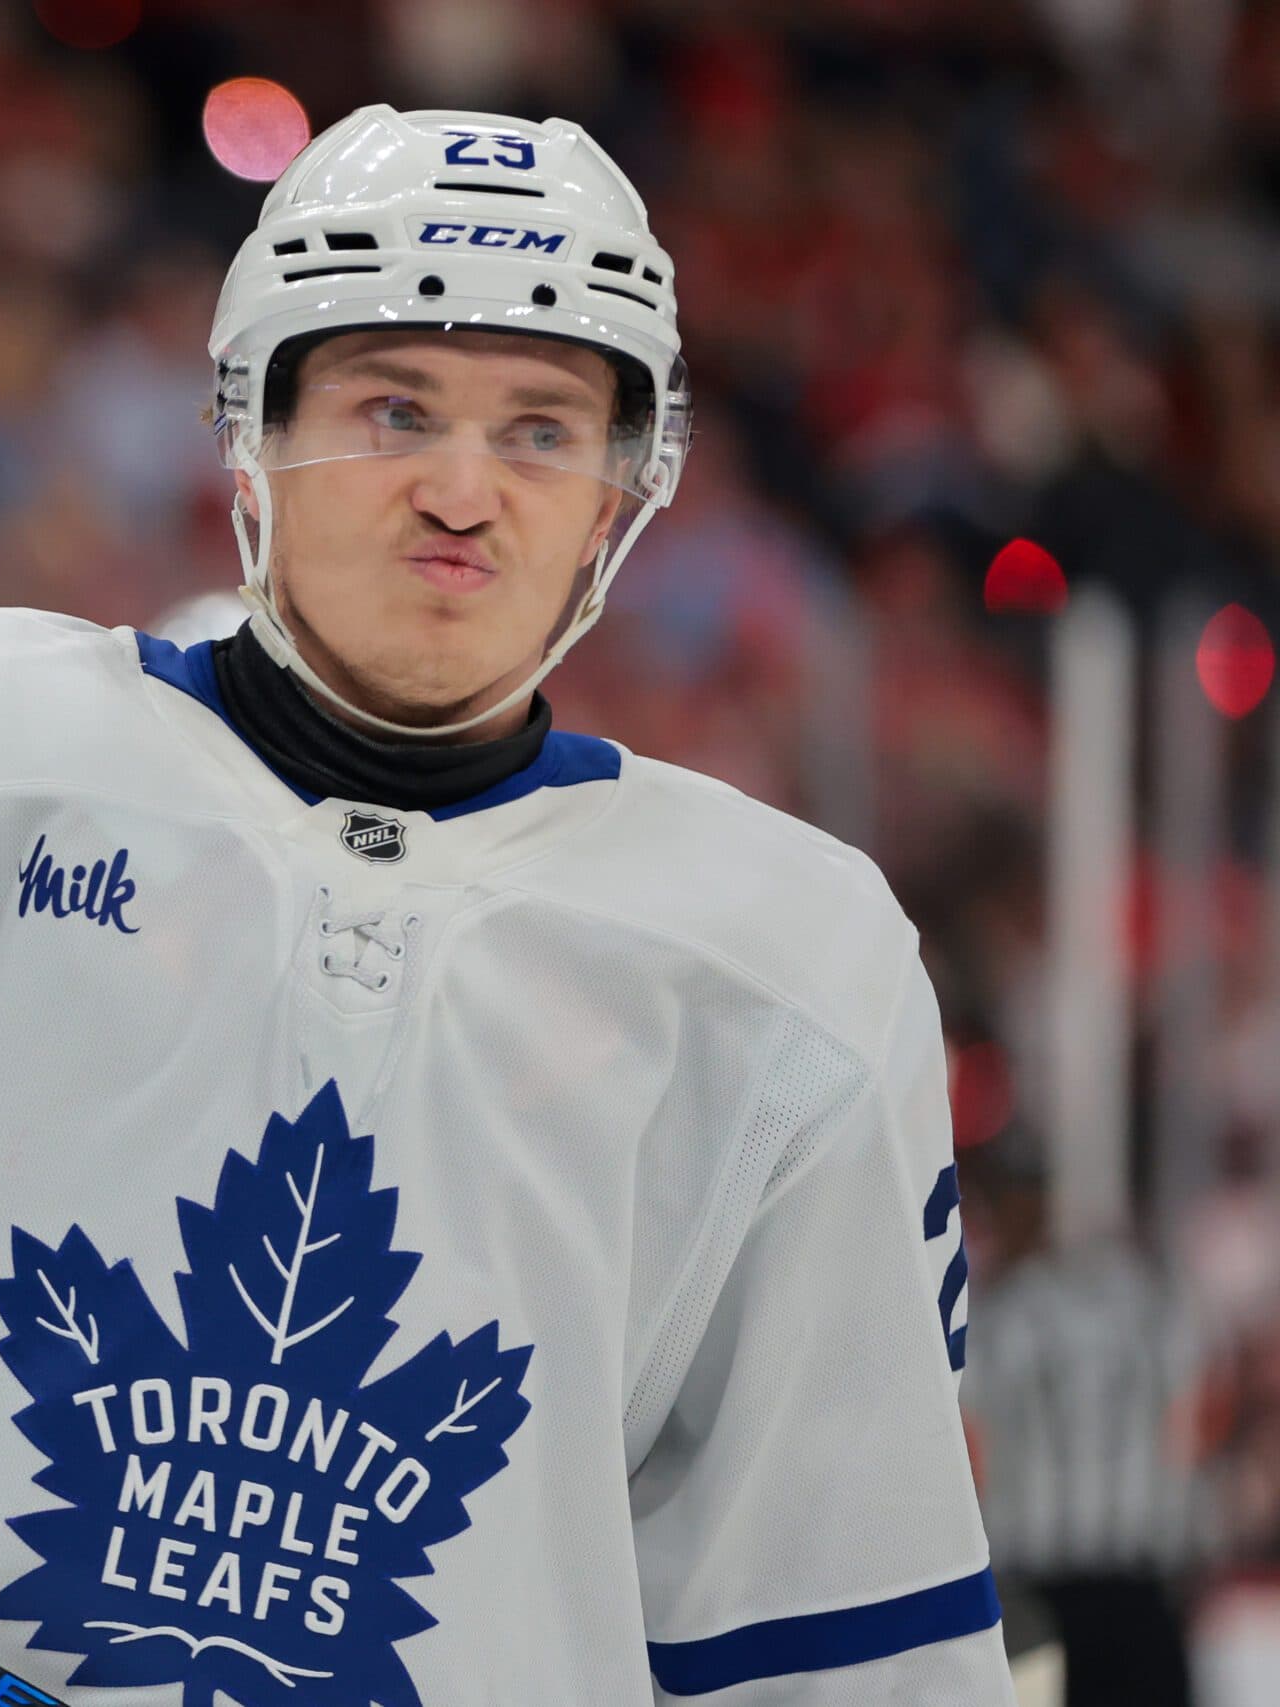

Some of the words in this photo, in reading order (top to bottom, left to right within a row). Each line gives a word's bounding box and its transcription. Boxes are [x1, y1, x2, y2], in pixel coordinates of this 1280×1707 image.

[419, 222, 567, 254] CCM
[19, 834, 141, 933] Milk
[352, 828, 395, 848] NHL
[73, 1376, 431, 1523] TORONTO
[118, 1454, 370, 1565] MAPLE
[101, 1526, 350, 1636] LEAFS
